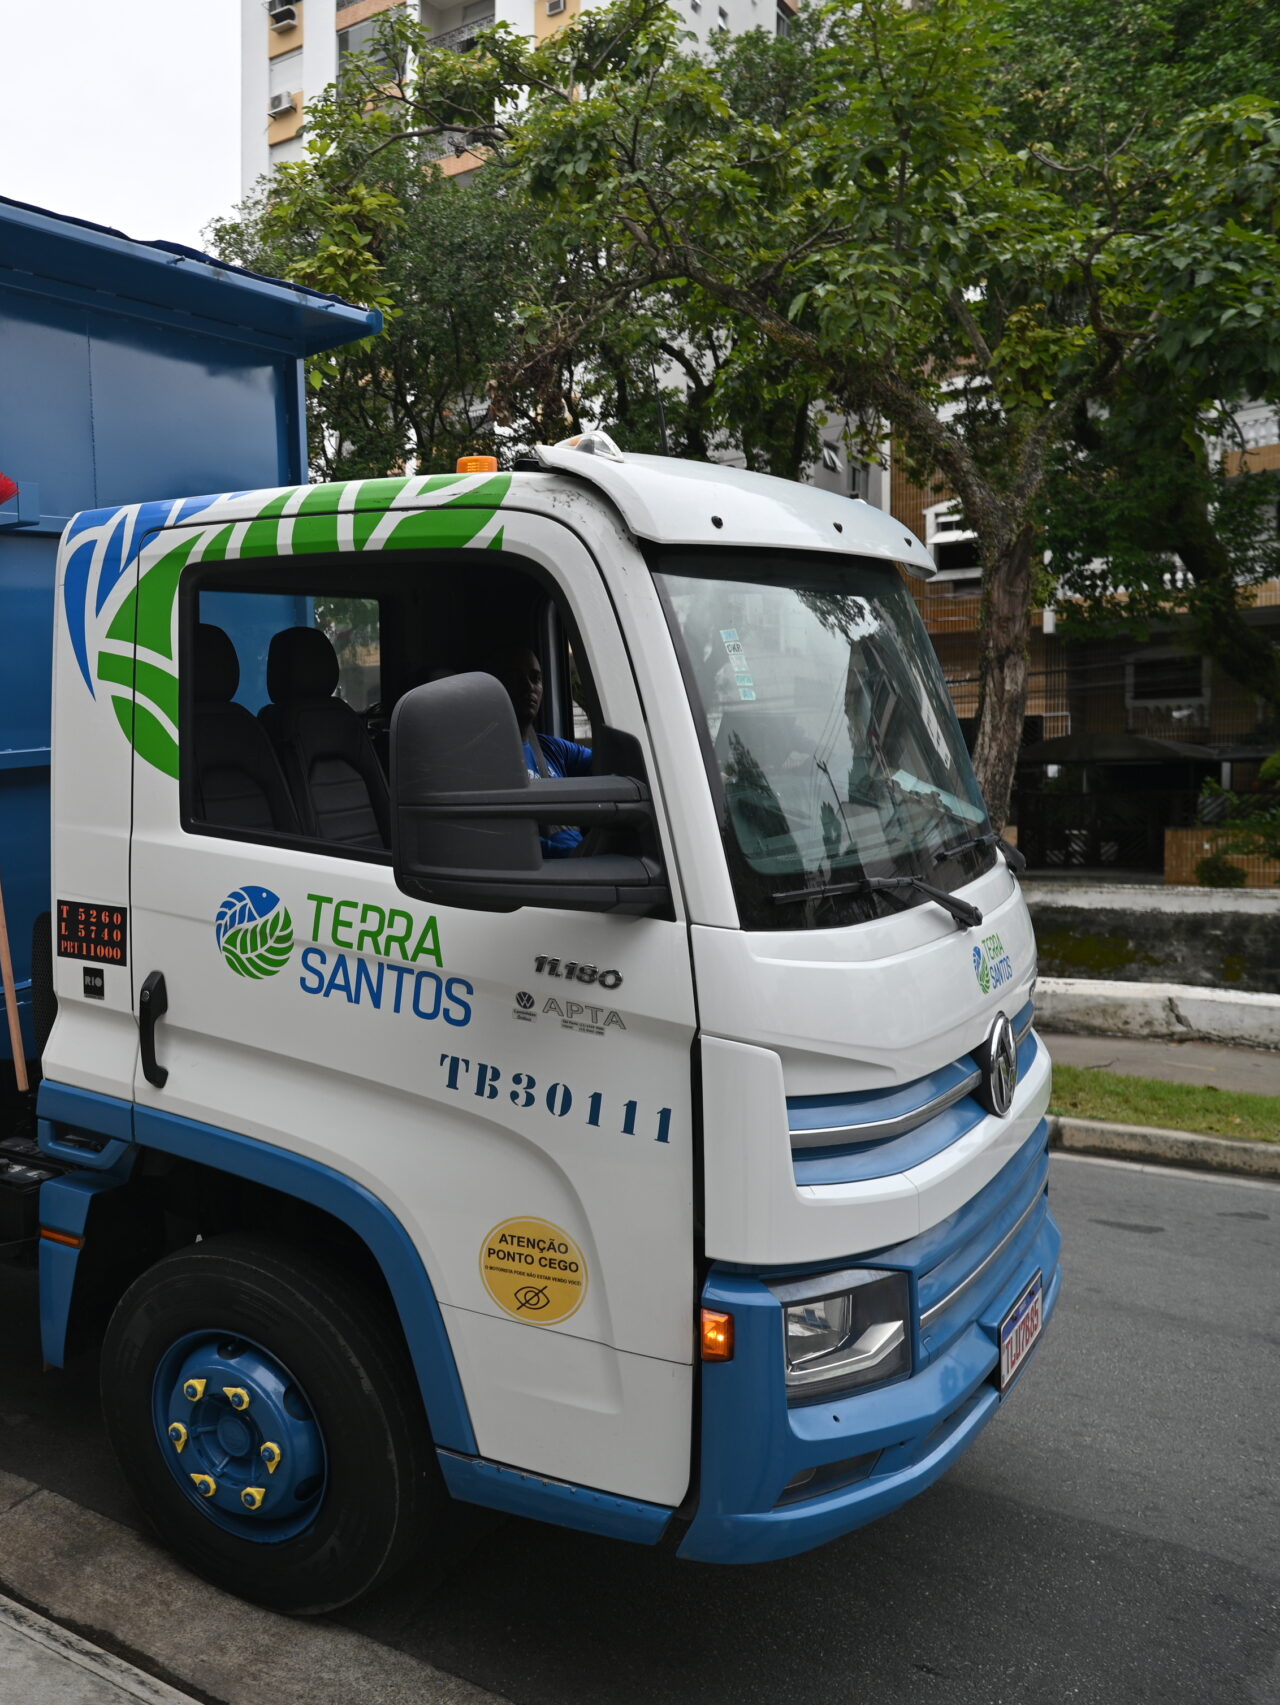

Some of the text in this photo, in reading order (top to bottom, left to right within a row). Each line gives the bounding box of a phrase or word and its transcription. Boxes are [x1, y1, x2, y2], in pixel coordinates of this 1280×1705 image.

[61, 905, 122, 925] T 5260
[61, 922, 122, 942] L 5740
[307, 893, 443, 968] TERRA
[82, 942, 121, 960] 11000
[982, 932, 1005, 962] TERRA
[85, 976, 103, 987] RIO
[534, 954, 624, 990] 11.180
[300, 947, 474, 1027] SANTOS
[542, 998, 627, 1030] APTA
[439, 1053, 673, 1144] TB30111
[499, 1233, 569, 1254] ATENÇÃO
[487, 1248, 579, 1273] PONTO CEGO
